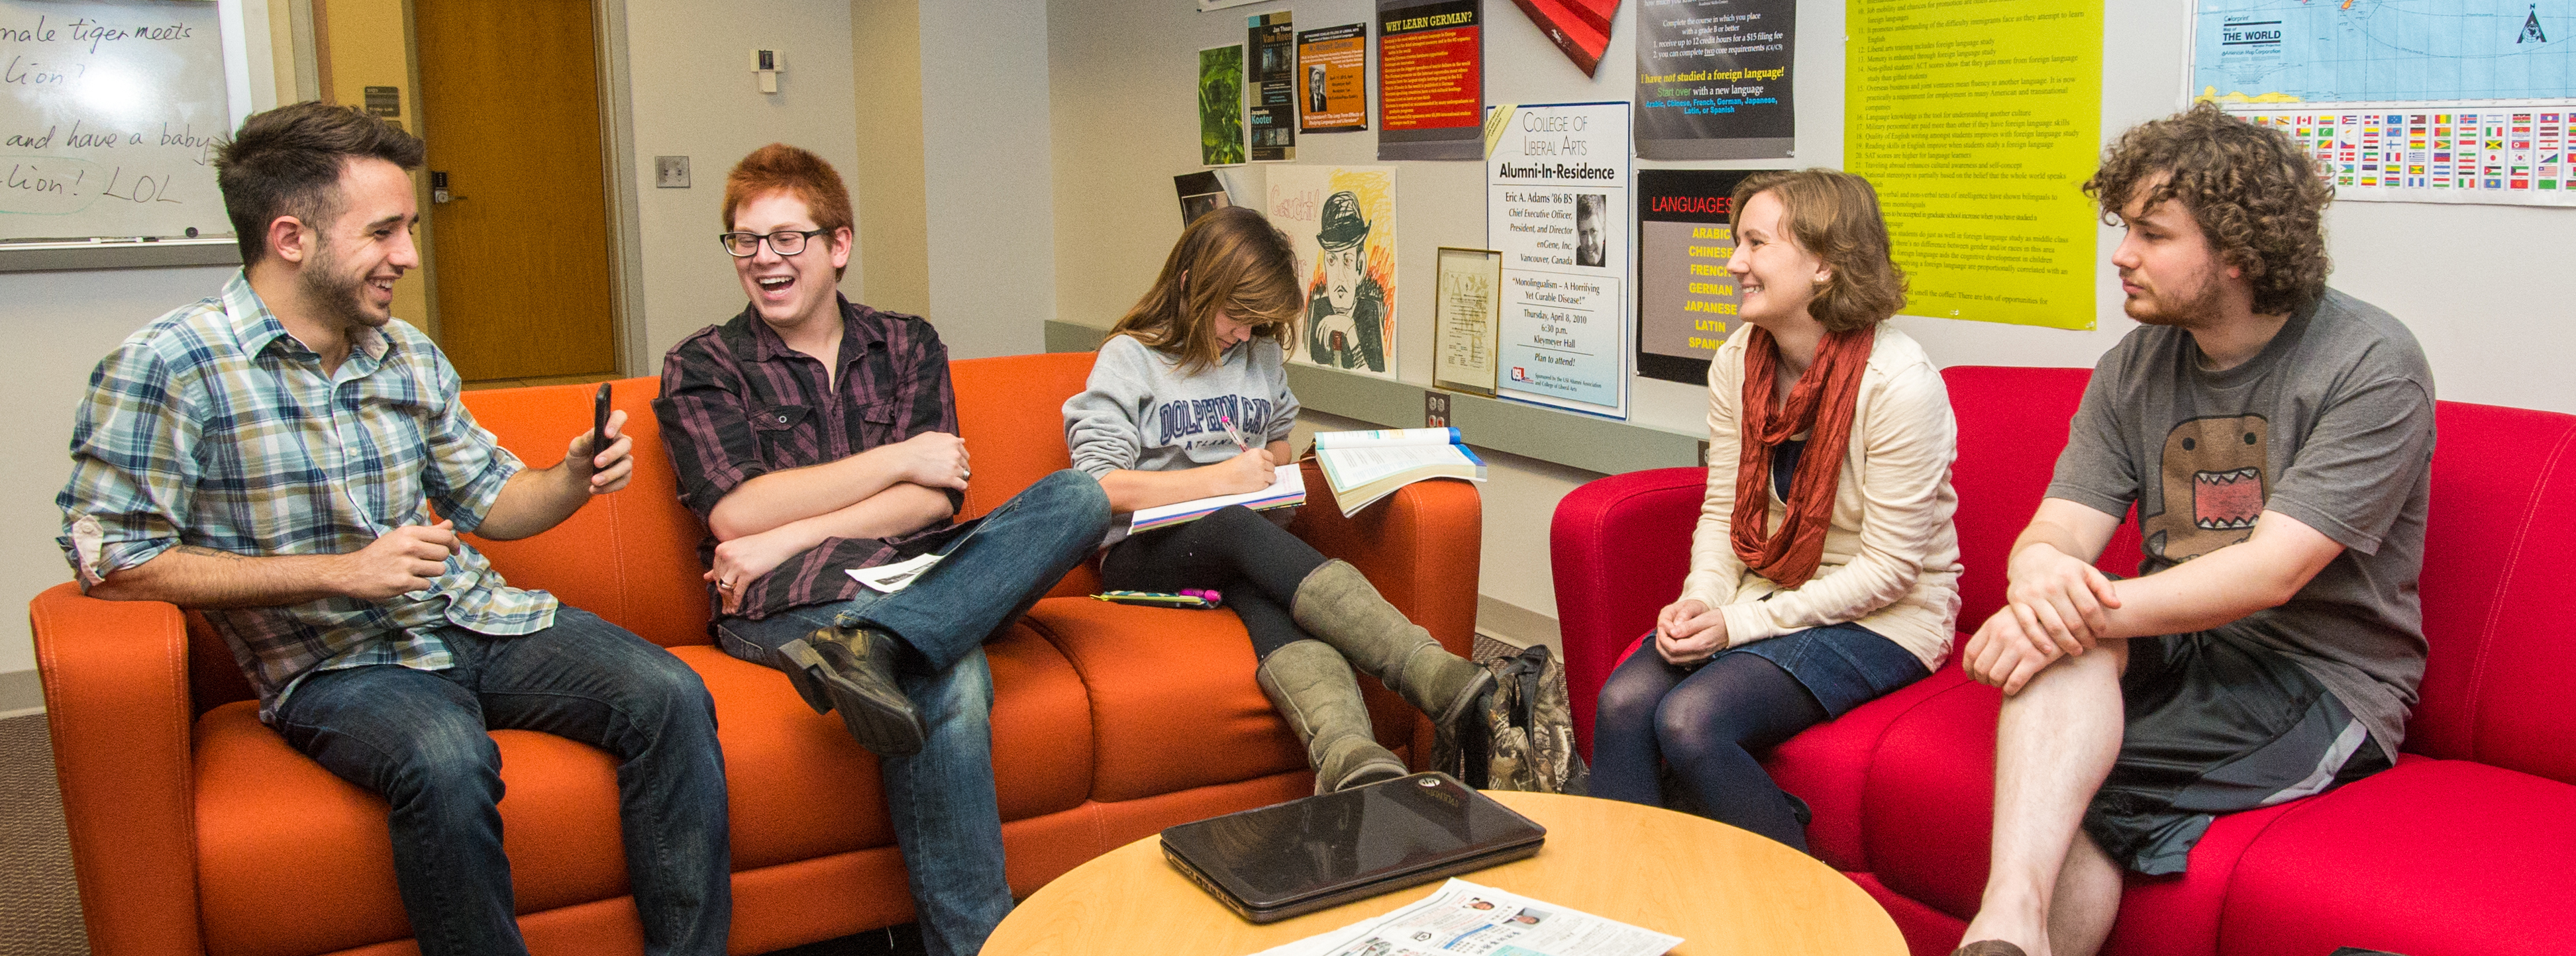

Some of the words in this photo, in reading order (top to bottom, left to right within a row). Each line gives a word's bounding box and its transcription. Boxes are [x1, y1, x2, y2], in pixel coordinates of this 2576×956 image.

[1386, 21, 1402, 32] WHY
[1403, 17, 1428, 30] LEARN
[1429, 11, 1472, 26] GERMAN?
[1663, 19, 1686, 28] Complete
[1719, 14, 1735, 23] which
[1735, 15, 1746, 24] you
[1747, 12, 1761, 23] place
[69, 19, 129, 54] tiger
[134, 22, 192, 40] meets
[1262, 34, 1275, 43] Van
[1276, 32, 1292, 42] Rees
[1698, 26, 1713, 36] grade
[2223, 32, 2241, 41] THE
[2245, 30, 2281, 40] WORLD
[1677, 40, 1686, 48] up
[1699, 36, 1716, 45] credit
[1716, 35, 1732, 44] hours
[1746, 32, 1757, 42] $15
[1757, 32, 1773, 42] filing
[1774, 30, 1783, 39] fee
[1658, 51, 1669, 60] you
[1679, 48, 1704, 58] complete
[1728, 45, 1765, 56] requirements
[2051, 55, 2079, 64] language
[1641, 73, 1644, 83] I
[1645, 73, 1662, 83] have
[1664, 72, 1676, 82] not
[1676, 70, 1706, 82] studied
[1713, 69, 1743, 83] foreign
[1744, 66, 1784, 81] language!
[1657, 87, 1674, 97] Start
[1675, 88, 1692, 97] over
[1692, 85, 1709, 96] with
[1731, 84, 1764, 97] language
[1693, 98, 1716, 107] French,
[1717, 97, 1743, 106] German,
[1745, 97, 1778, 105] Japanese,
[1710, 106, 1735, 115] Spanish
[1251, 115, 1272, 124] Kooter
[1573, 116, 1588, 132] OF
[2027, 120, 2053, 128] language
[6, 125, 56, 149] and
[67, 119, 117, 148] have
[130, 132, 142, 144] a
[161, 122, 210, 166] baby
[1500, 162, 1615, 179] Alumni-In-Residence
[103, 166, 182, 204] LOL
[1506, 191, 1518, 202] Eric
[1518, 193, 1526, 203] A.
[1527, 192, 1550, 203] Adams
[1551, 193, 1562, 204] '86
[1564, 193, 1572, 204] BS
[1653, 197, 1732, 213] LANGUAGES
[1509, 208, 1524, 217] Chief
[1524, 209, 1550, 218] Executive
[1551, 210, 1572, 220] Officer,
[1510, 223, 1536, 233] President,
[1537, 224, 1547, 233] and
[1549, 225, 1573, 234] Director
[1692, 227, 1731, 240] ARABIC
[1537, 240, 1560, 250] enGene,
[1561, 241, 1572, 250] Inc.
[1689, 246, 1734, 258] CHINESE
[1520, 253, 1550, 265] Vancouver,
[1551, 255, 1572, 265] Canada
[1571, 282, 1600, 296] Horrifying
[1689, 282, 1733, 296] GERMAN
[1535, 292, 1556, 302] Curable
[1684, 300, 1737, 315] JAPANESE
[1524, 309, 1549, 321] Thursday,
[1551, 312, 1564, 323] April
[1565, 314, 1571, 323] 8,
[1573, 314, 1587, 324] 2010
[1555, 326, 1568, 336] p.m.
[1695, 319, 1726, 333] LATIN
[1534, 335, 1562, 348] Kleymeyer
[1564, 339, 1575, 348] Hall
[1688, 336, 1725, 350] SPANI
[1535, 353, 1546, 362] Plan
[1555, 358, 1575, 367] attend!
[1159, 394, 1239, 446] DOLPHIN
[1241, 397, 1272, 435] CAY
[1185, 438, 1249, 450] ATLANTS
